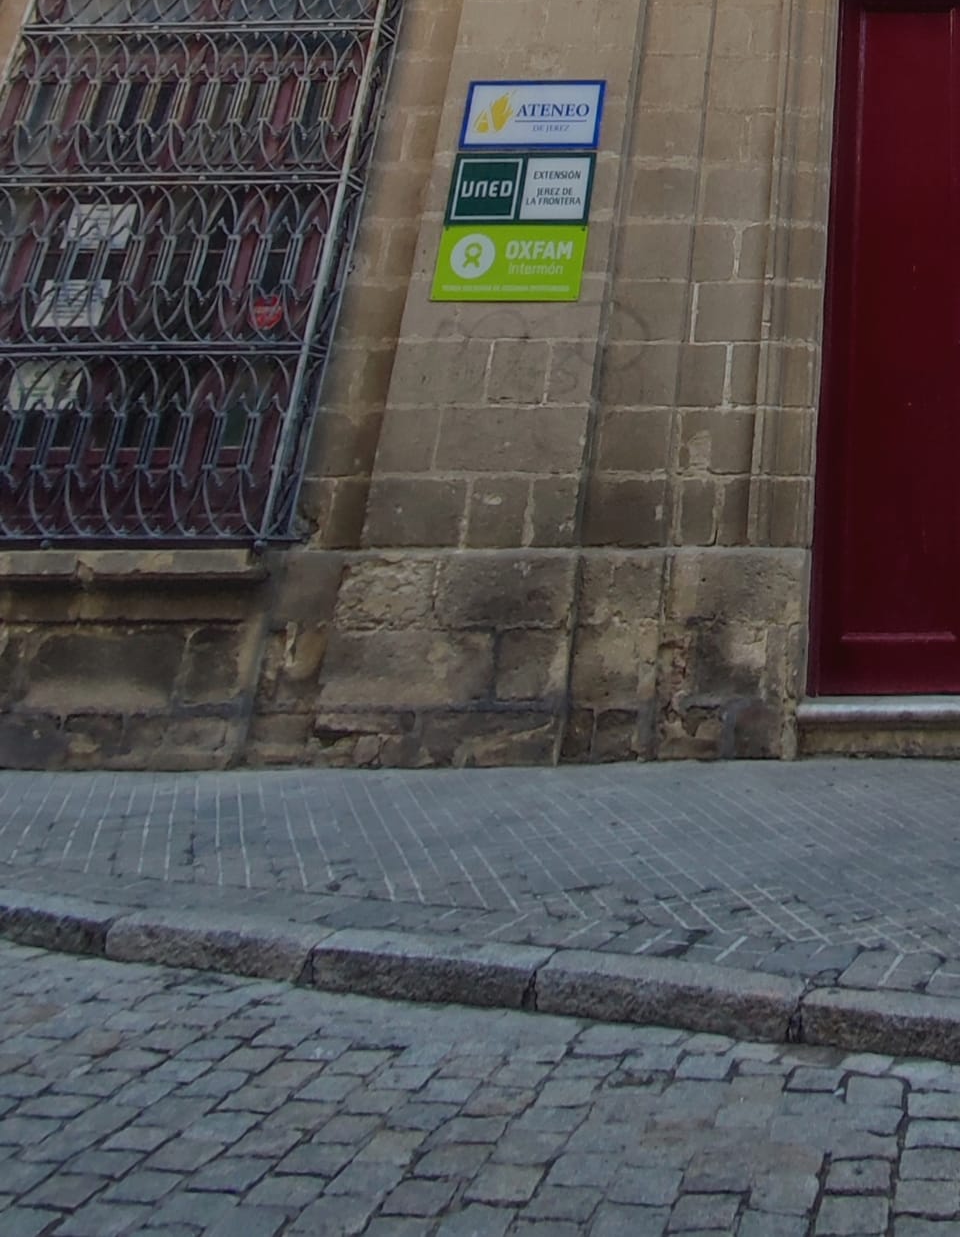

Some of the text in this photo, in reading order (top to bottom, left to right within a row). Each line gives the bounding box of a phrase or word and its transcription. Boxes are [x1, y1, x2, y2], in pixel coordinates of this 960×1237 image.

[516, 103, 590, 117] ATENEO
[532, 124, 570, 133] DE JEREZ
[533, 170, 581, 180] EXTENSIÓN
[460, 180, 513, 198] UNED
[536, 187, 573, 197] JEREZ DE
[525, 197, 582, 206] LA FRONTERA
[505, 240, 573, 260] OXFAM
